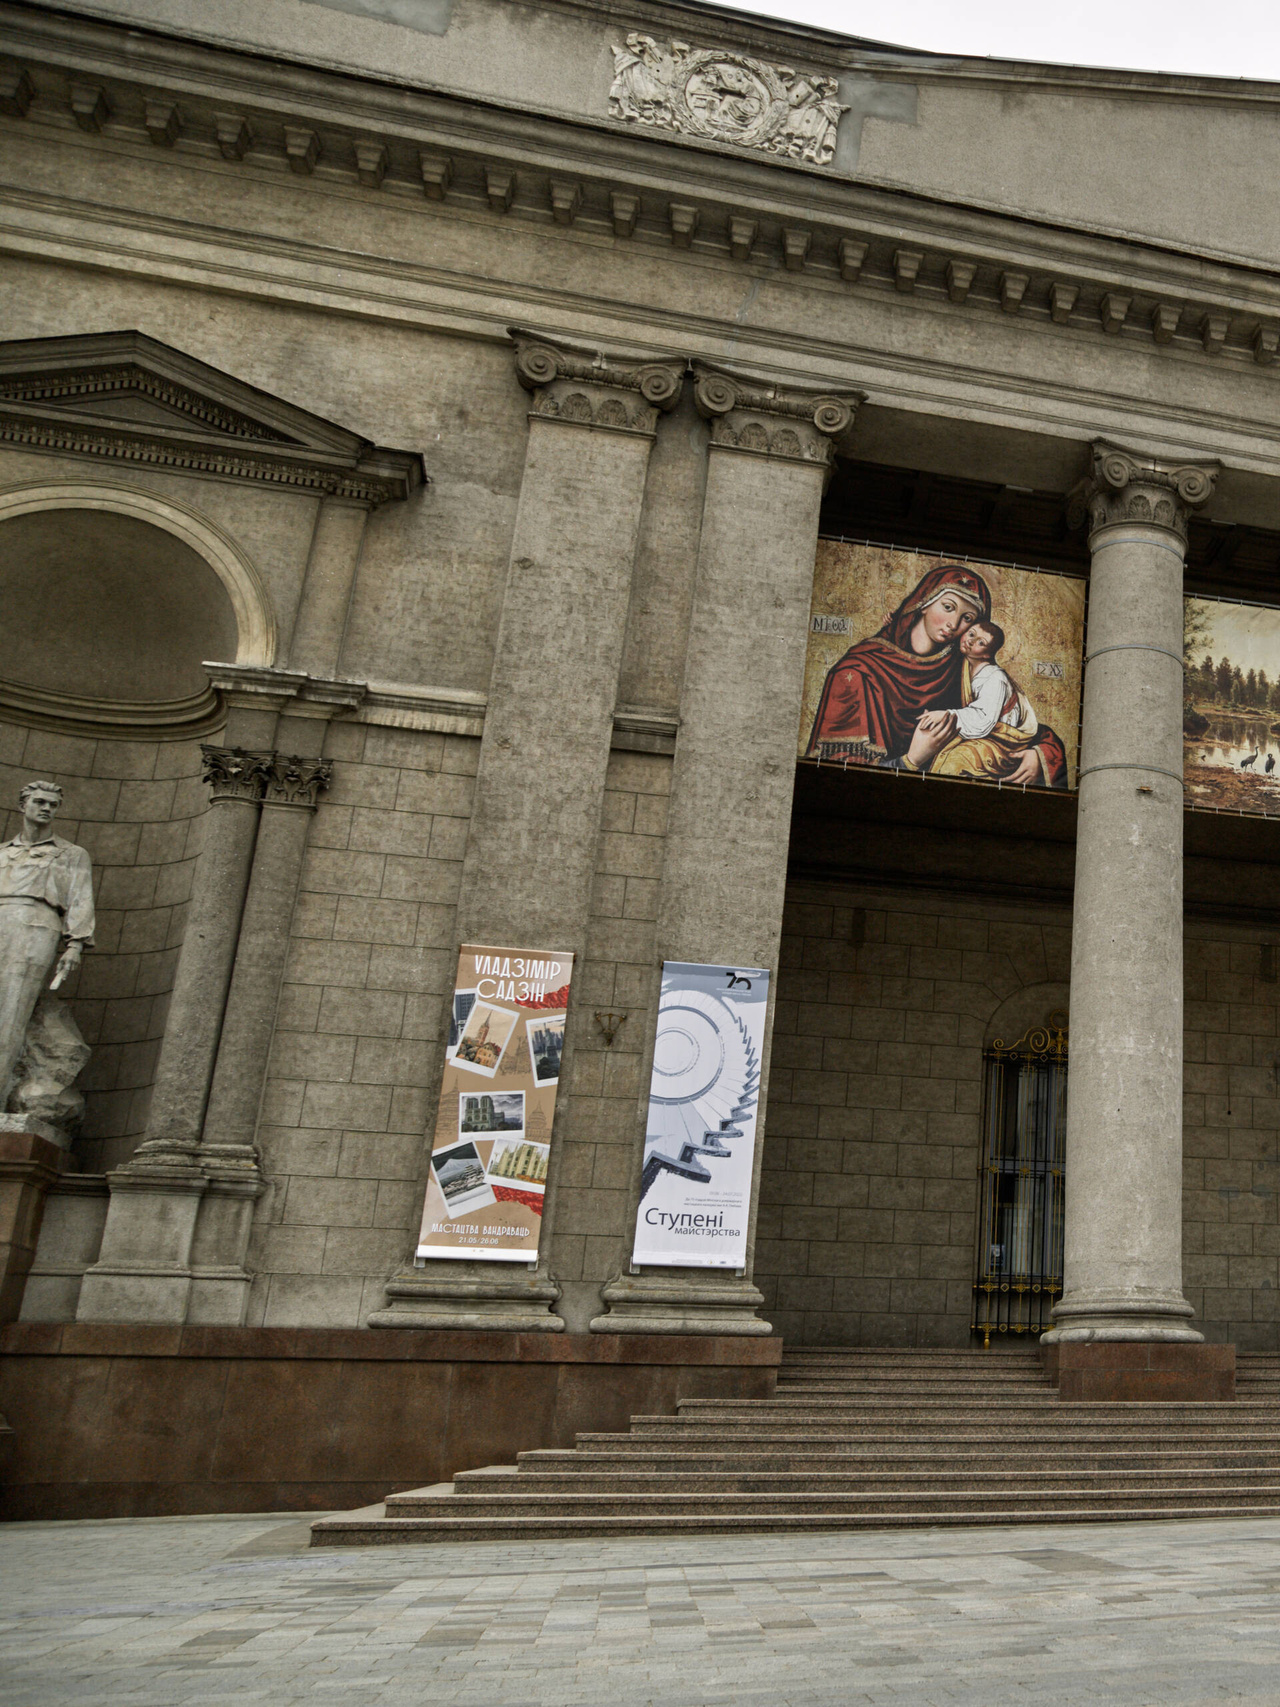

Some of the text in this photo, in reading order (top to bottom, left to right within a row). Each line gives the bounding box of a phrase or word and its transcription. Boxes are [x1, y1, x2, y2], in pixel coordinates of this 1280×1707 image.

[475, 955, 561, 980] УЛАДЗІМІР
[477, 978, 545, 1002] САДЗІН
[431, 1223, 530, 1237] МАСТАЦТВА ВАНДРАВАЦЬ
[645, 1207, 723, 1230] Ступені
[674, 1226, 741, 1237] майстэрства
